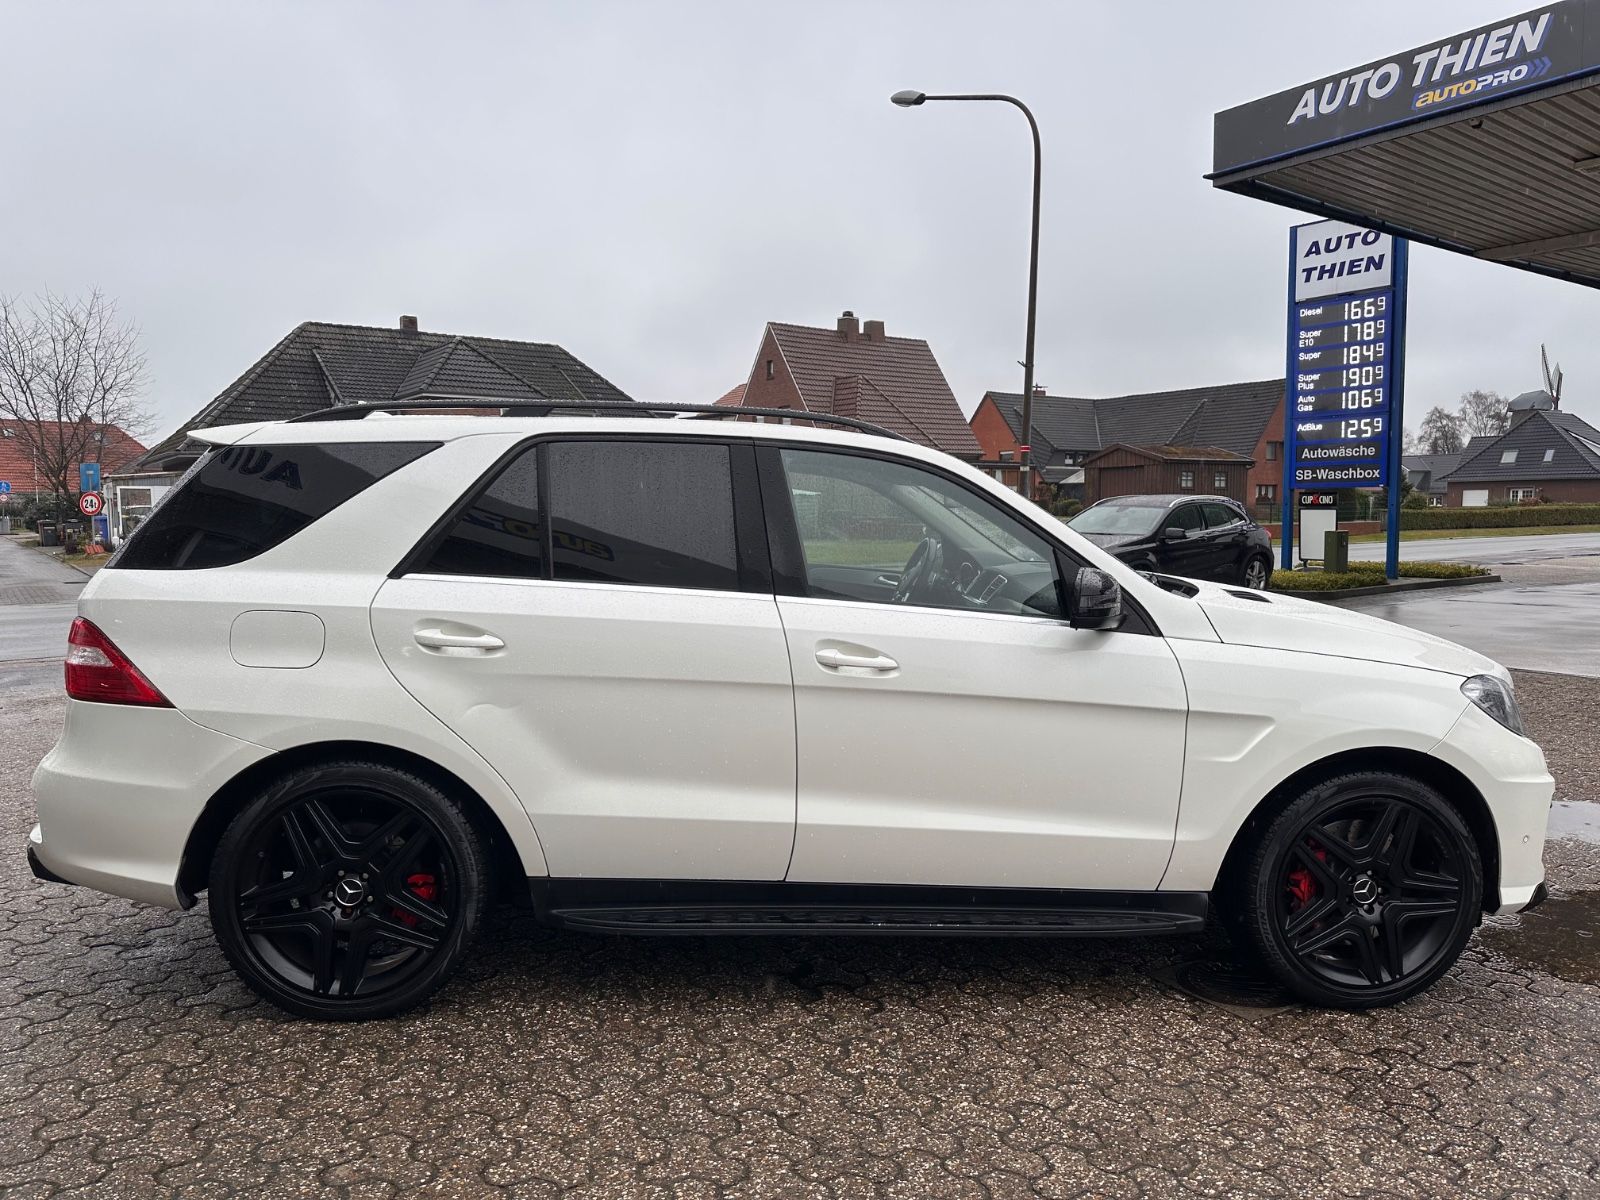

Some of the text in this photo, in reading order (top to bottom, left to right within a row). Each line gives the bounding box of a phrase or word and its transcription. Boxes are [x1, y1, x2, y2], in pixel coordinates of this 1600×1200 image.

[1287, 12, 1552, 125] AUTO THIEN
[1303, 229, 1381, 258] AUTO
[1301, 253, 1386, 283] THIEN
[1300, 306, 1323, 317] Diesel
[1299, 329, 1322, 340] Super
[1298, 338, 1314, 348] E10
[1298, 351, 1322, 361] Super
[1298, 373, 1321, 383] Super
[1297, 382, 1314, 391] Plus
[1297, 395, 1315, 404] Auto
[1297, 404, 1313, 412] Gas
[1297, 422, 1323, 432] AdBlue
[1301, 444, 1376, 459] Autowäsche
[1295, 467, 1380, 481] SB-Waschbox
